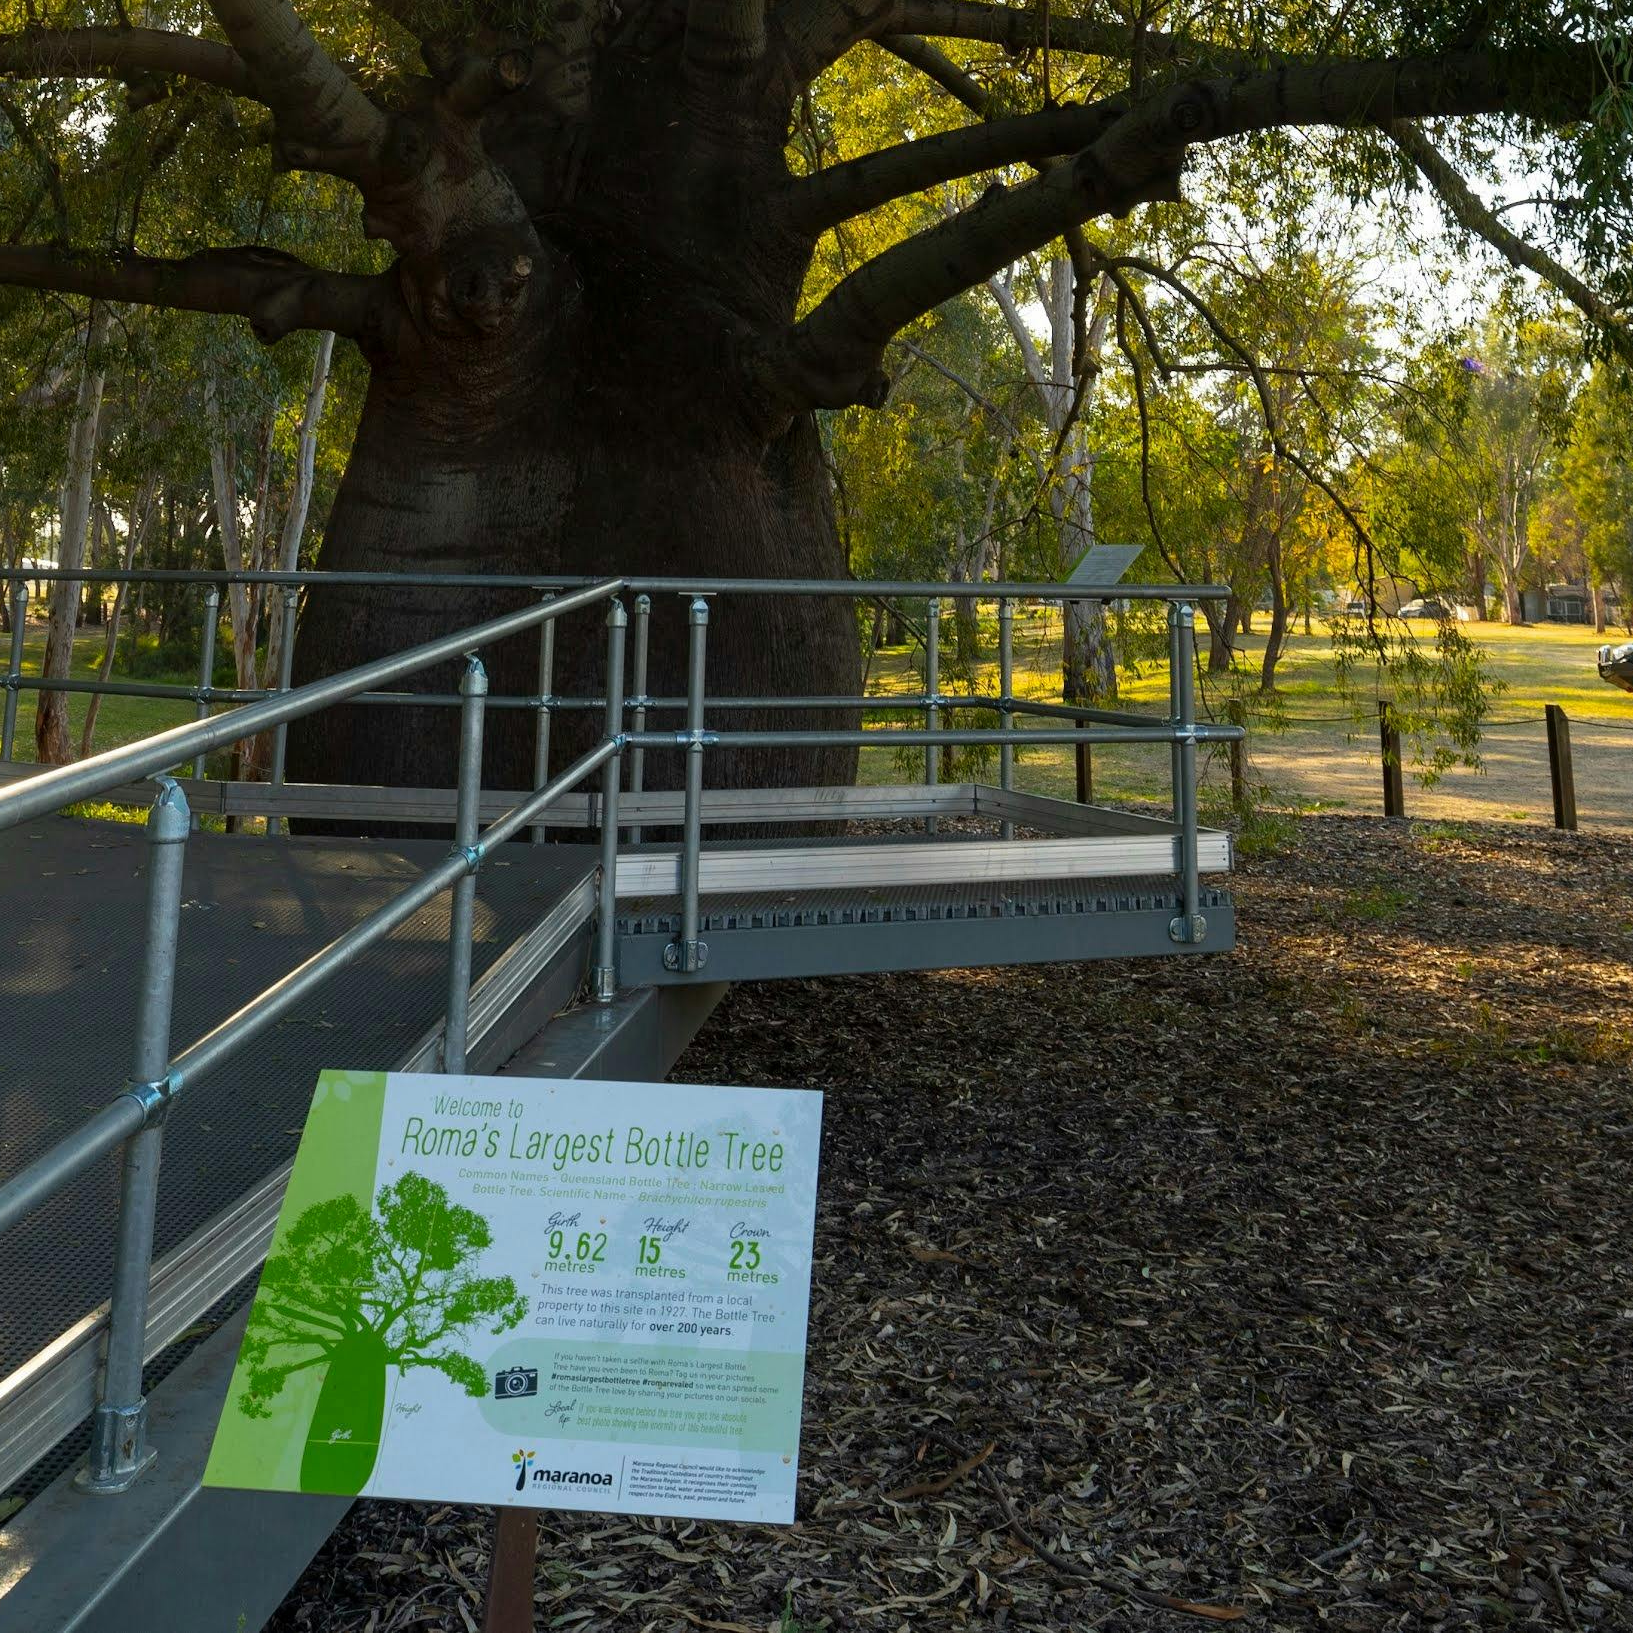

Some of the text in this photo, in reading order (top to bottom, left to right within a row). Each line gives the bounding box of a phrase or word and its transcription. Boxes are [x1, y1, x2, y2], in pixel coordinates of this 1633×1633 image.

[433, 1095, 523, 1118] Welcome to
[403, 1117, 784, 1173] Roma's Largest Bottle Tree
[458, 1168, 784, 1194] Common Names Queensland Bottle Tree Narrow Leaved
[472, 1183, 767, 1210] Bottle Tree. Scientific Name Brachychiton rupestris
[545, 1211, 580, 1236] Girth
[642, 1217, 689, 1243] Height
[730, 1221, 771, 1240] Crown
[548, 1230, 607, 1261] 9.62
[638, 1235, 661, 1264] 15
[729, 1240, 760, 1270] 23
[545, 1260, 595, 1273] metres
[635, 1265, 686, 1278] metres
[727, 1270, 778, 1284] metres
[540, 1283, 752, 1306] This tree was transplanted from a local
[537, 1300, 774, 1322] property to this site in 1927. The Bottle Tree
[535, 1316, 735, 1338] can live naturally for over 200 years.
[575, 1354, 600, 1362] haven't
[667, 1359, 693, 1367] Roma's
[696, 1361, 722, 1371] Largest
[725, 1362, 746, 1371] Bottle
[551, 1373, 640, 1386] #romaslargestbottletree
[733, 1384, 757, 1394] spread
[648, 1368, 673, 1377] Roma?
[675, 1370, 687, 1378] Tag
[708, 1373, 723, 1381] your
[726, 1374, 755, 1383] pictures
[595, 1386, 611, 1394] Tree
[628, 1388, 636, 1397] by
[637, 1389, 665, 1399] sharing
[666, 1392, 682, 1400] your
[684, 1392, 713, 1401] pictures
[545, 1397, 575, 1418] Local
[532, 1483, 611, 1494] REGIONAL COUNCIL
[533, 1469, 613, 1486] maranoa
